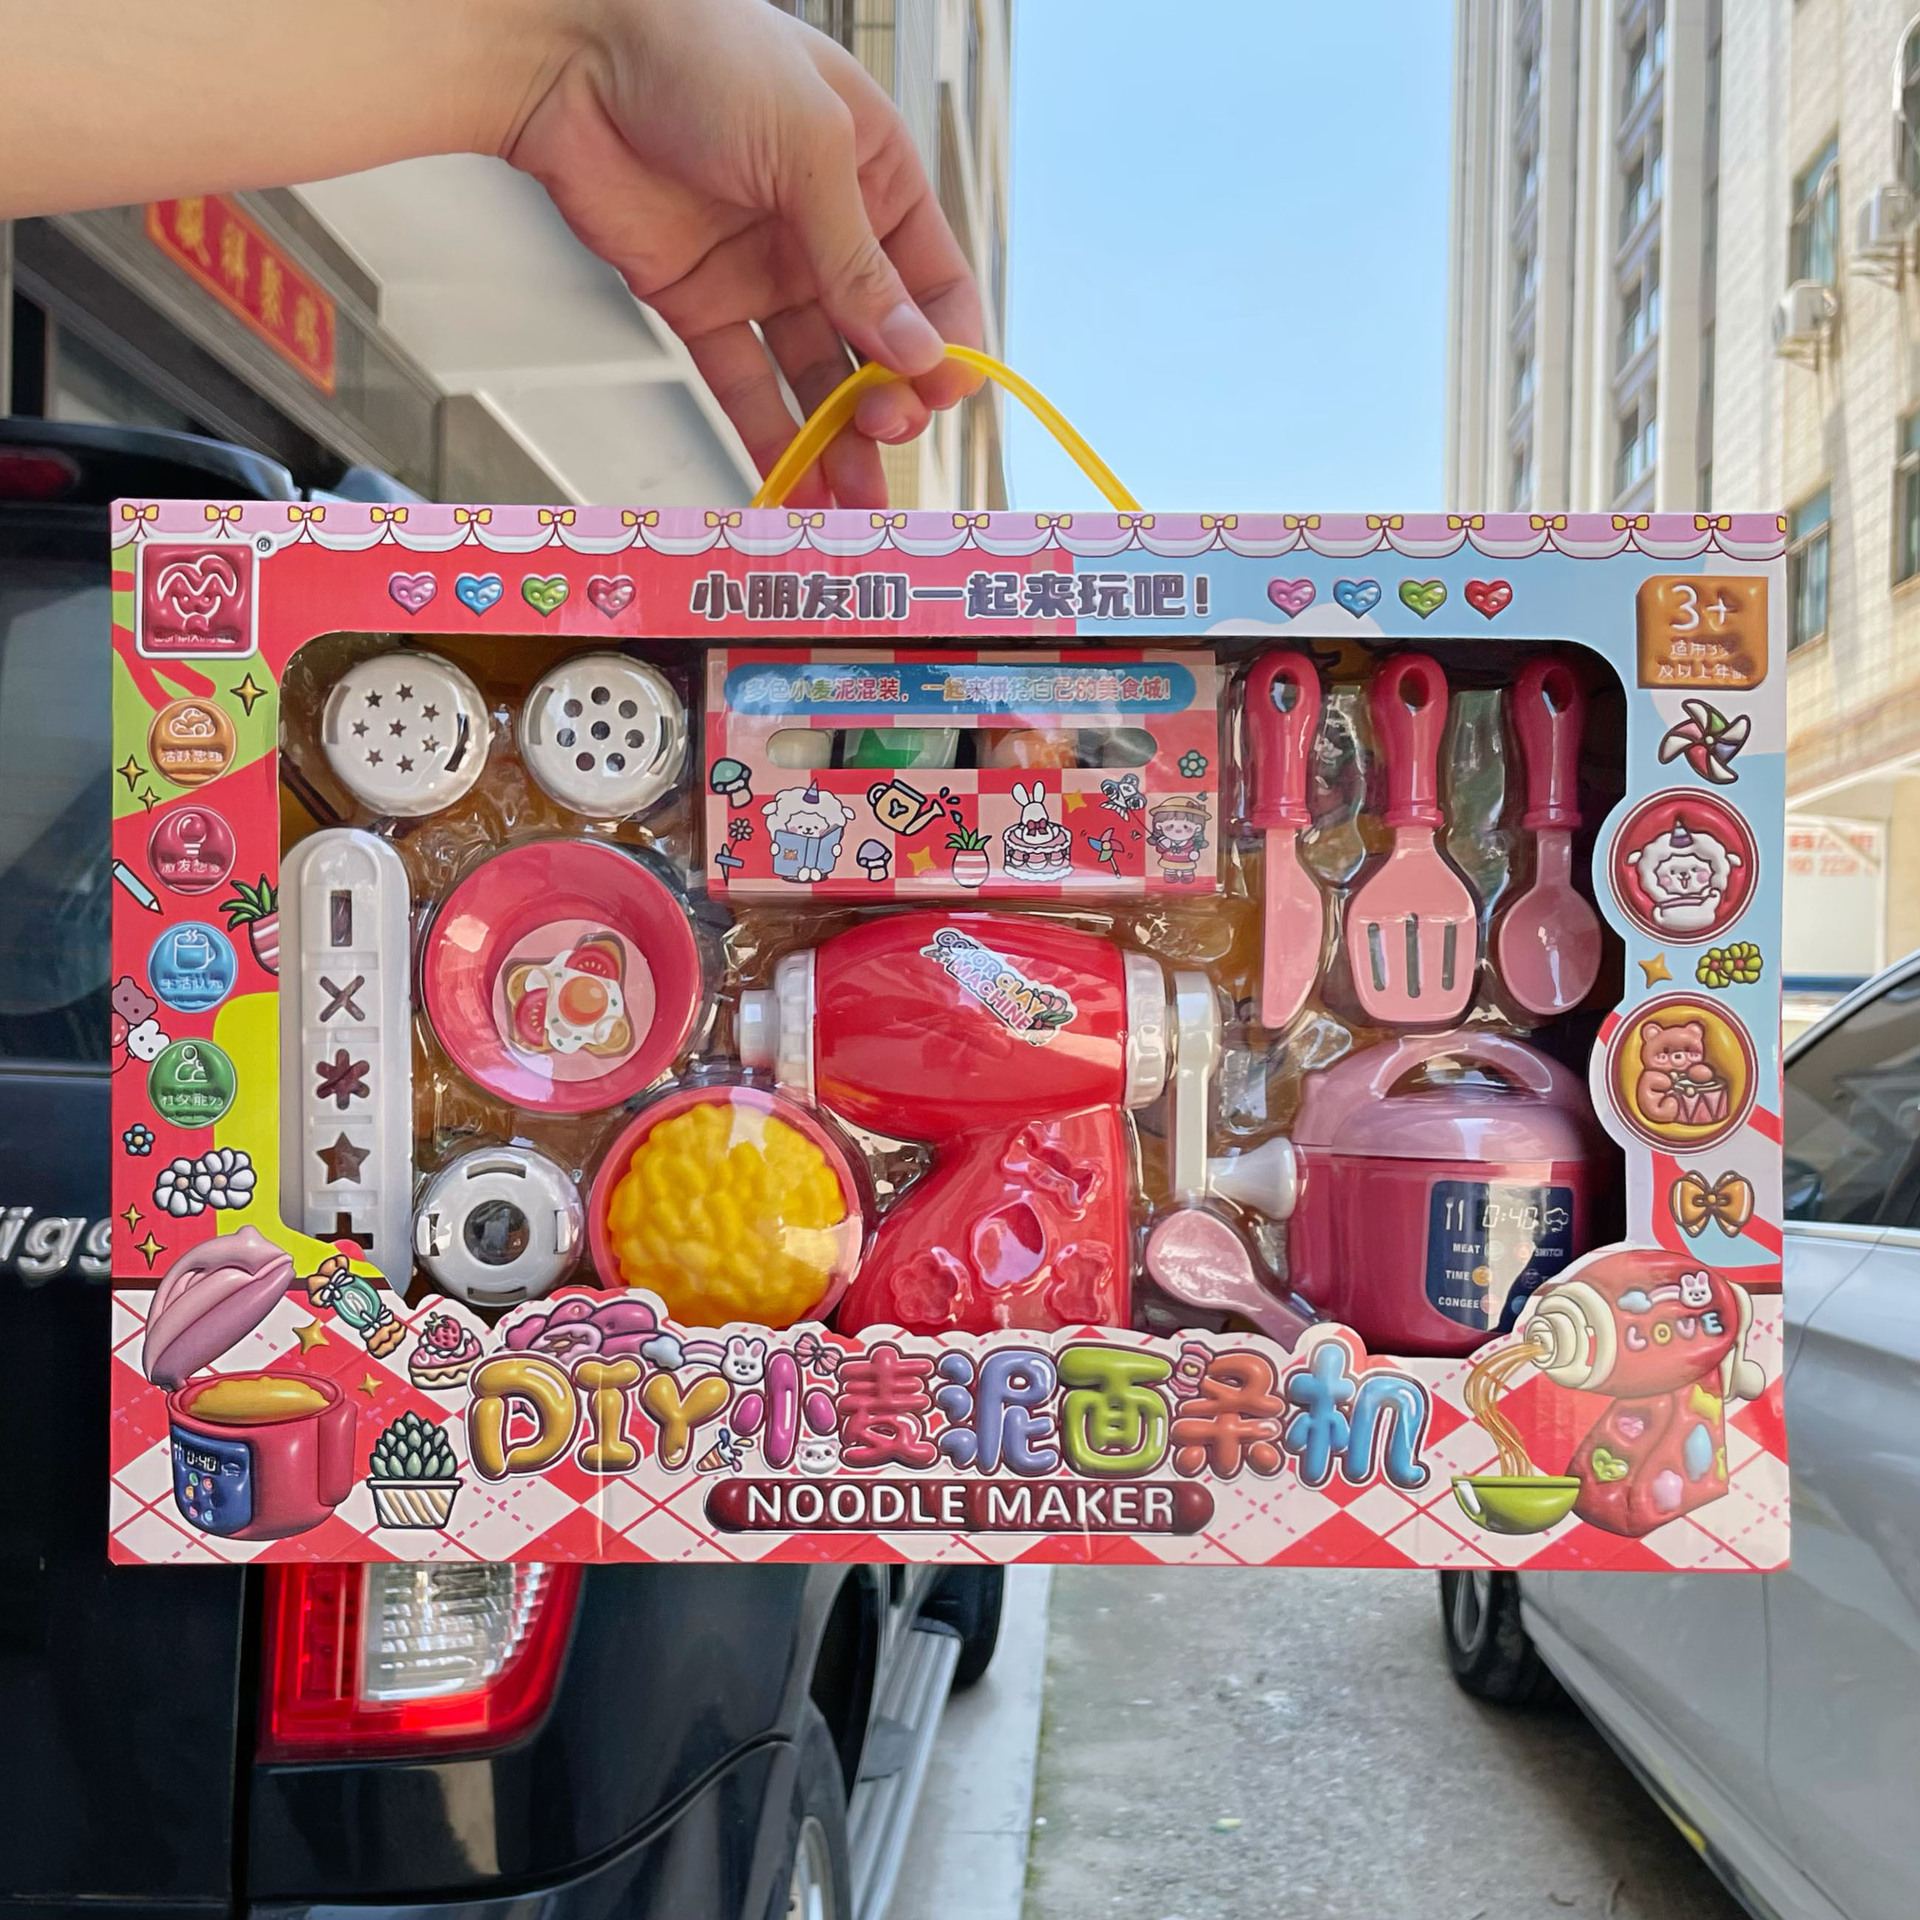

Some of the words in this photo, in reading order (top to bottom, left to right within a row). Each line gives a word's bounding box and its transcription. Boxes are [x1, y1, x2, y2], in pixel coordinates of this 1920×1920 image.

[690, 572, 1208, 619] 小朋友们一起来玩吧！
[1670, 584, 1733, 631] 3+
[949, 959, 1033, 1031] MACHINE
[995, 972, 1047, 1016] CLAY
[1452, 1242, 1481, 1255] MEAT
[1445, 1269, 1471, 1282] TIME
[1438, 1296, 1480, 1309] CONGEE
[1624, 1310, 1724, 1351] LOVE
[746, 1483, 969, 1526] NOODLE
[986, 1485, 1174, 1526] MAKER
